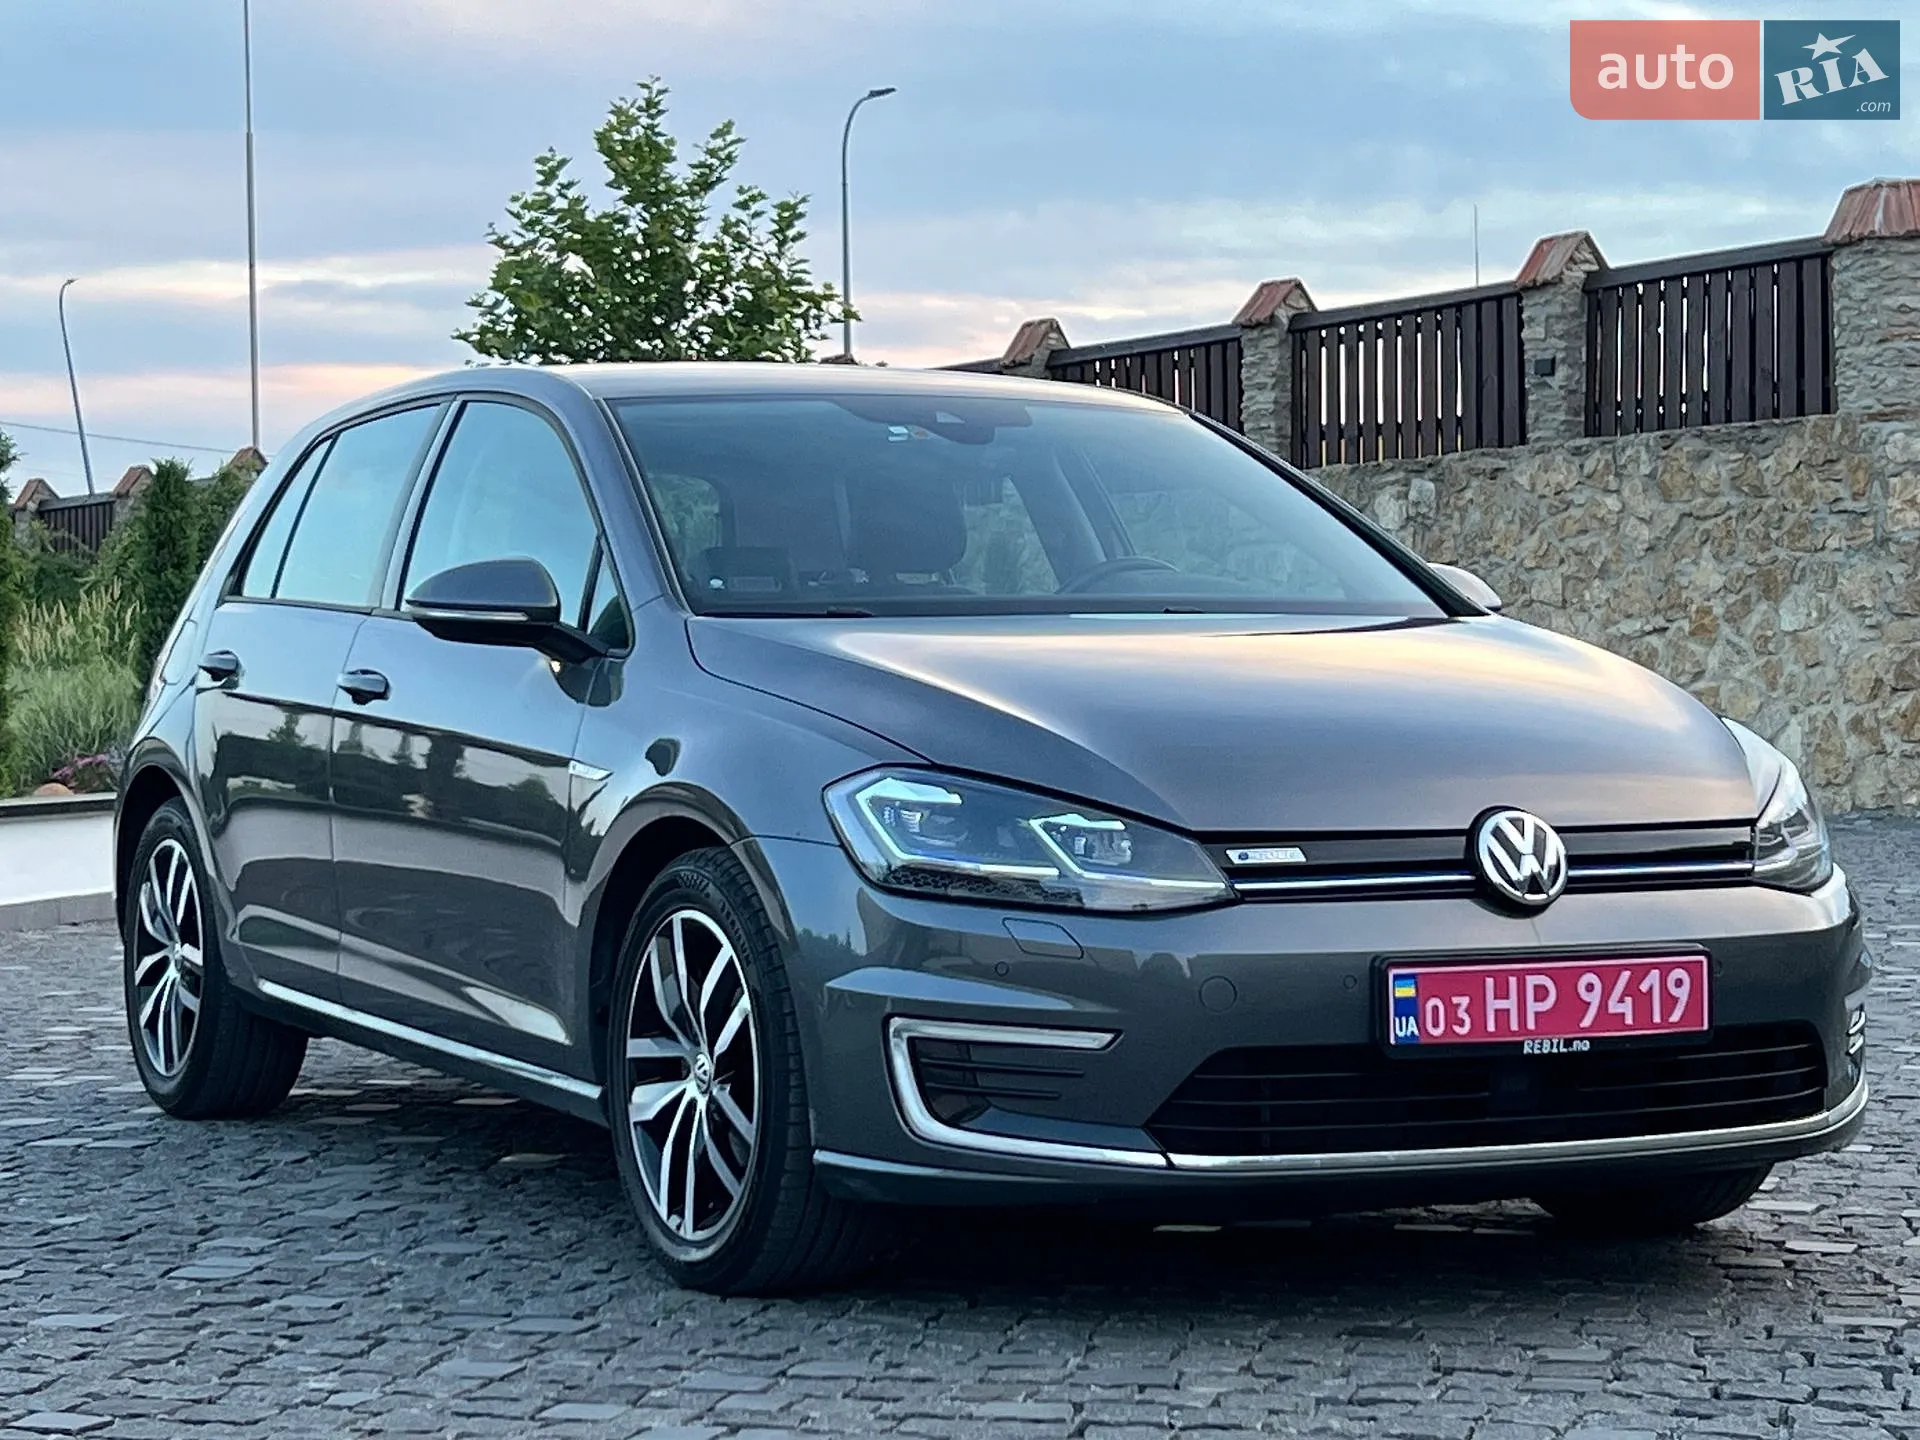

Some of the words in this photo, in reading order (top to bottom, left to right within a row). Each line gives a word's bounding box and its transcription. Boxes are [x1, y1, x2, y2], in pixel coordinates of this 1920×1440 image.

[1425, 995, 1472, 1037] 03
[1485, 974, 1557, 1032] HP
[1576, 968, 1691, 1028] 9419
[1395, 1016, 1419, 1037] UA
[1523, 1037, 1590, 1055] REBIL.no
